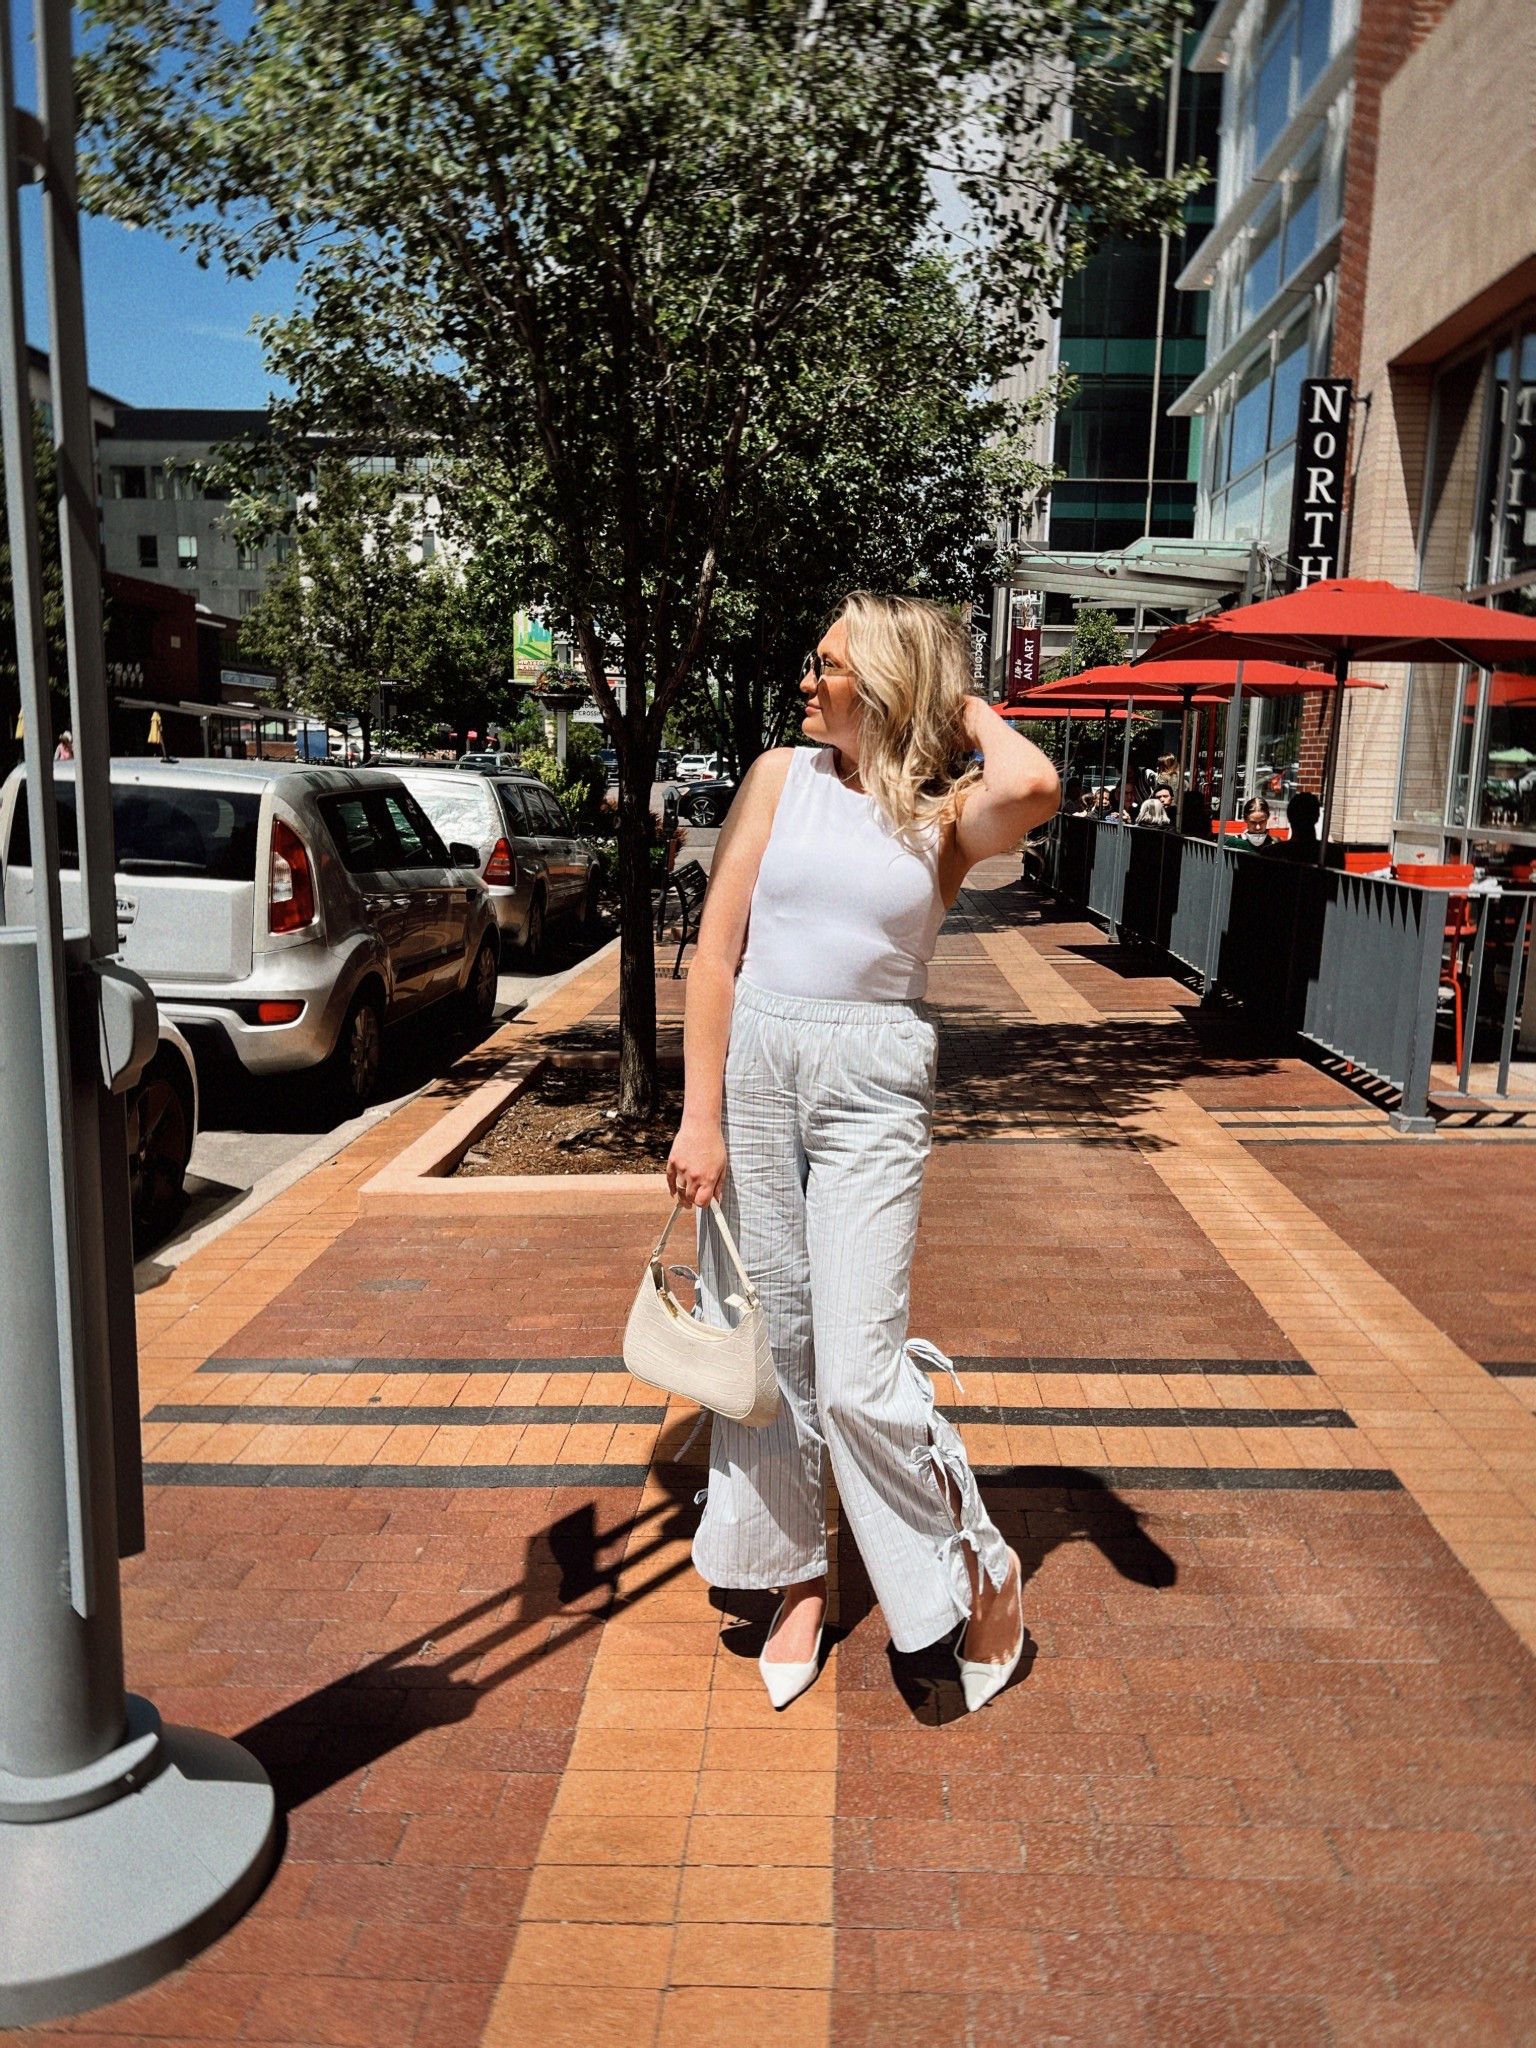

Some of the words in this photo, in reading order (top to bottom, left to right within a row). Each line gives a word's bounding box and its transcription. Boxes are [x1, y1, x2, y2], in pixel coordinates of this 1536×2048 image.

[973, 635, 987, 679] Second
[1024, 638, 1035, 660] ART
[1014, 666, 1023, 679] Life
[1023, 663, 1033, 681] AN
